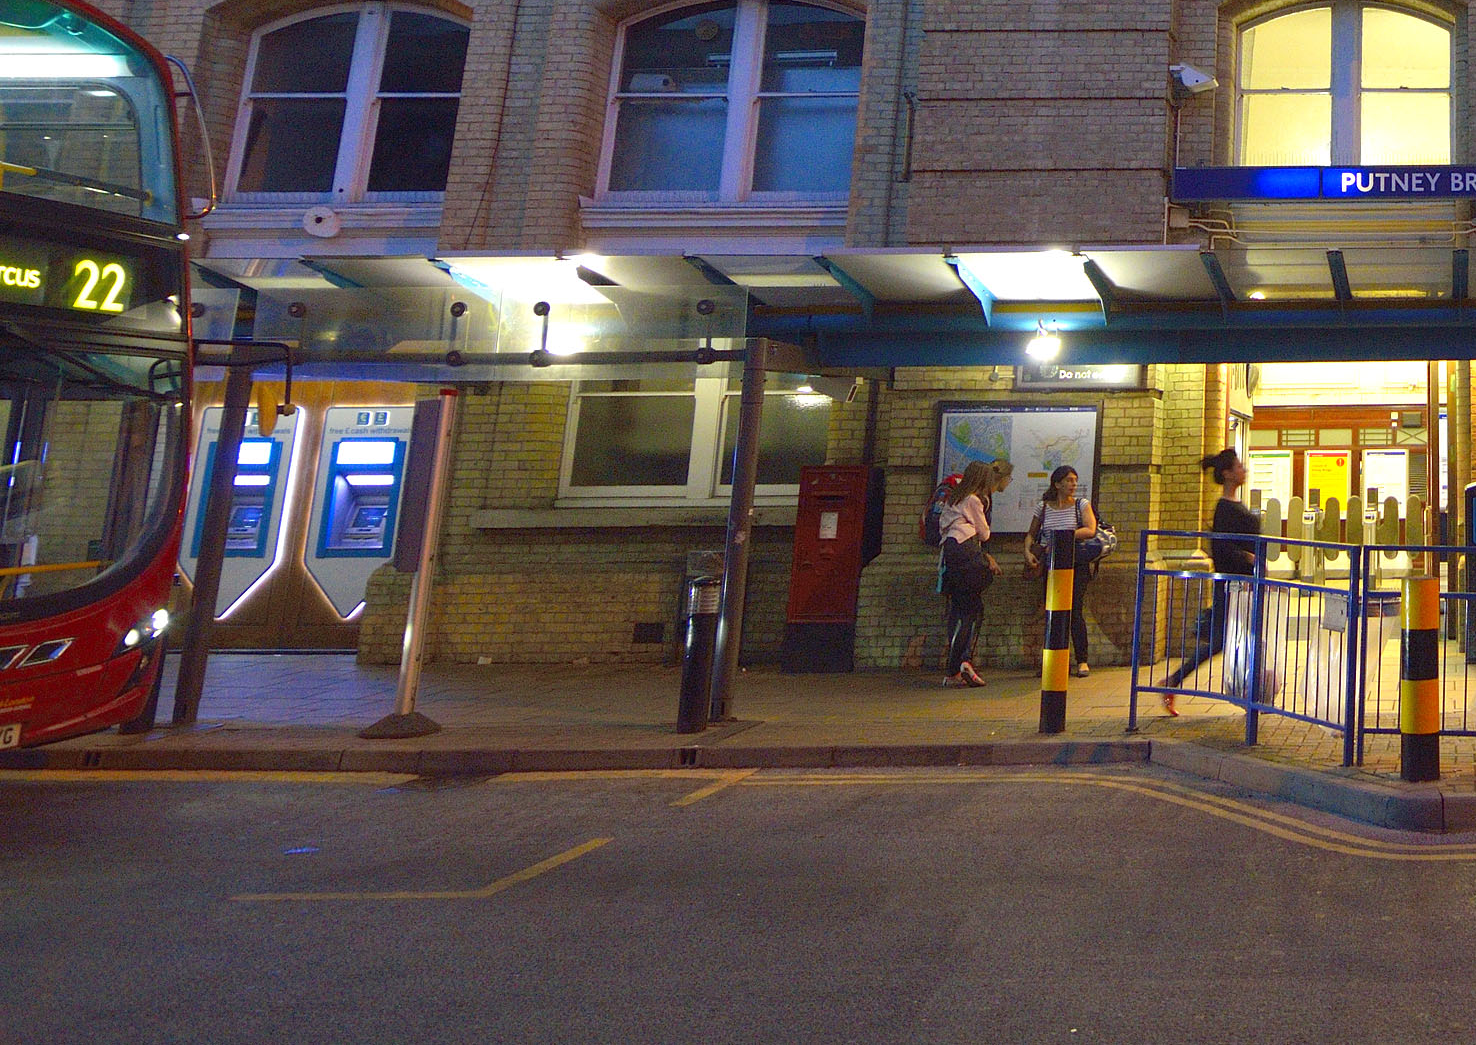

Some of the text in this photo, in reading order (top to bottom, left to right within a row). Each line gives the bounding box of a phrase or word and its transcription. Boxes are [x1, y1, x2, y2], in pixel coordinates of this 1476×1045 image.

[1341, 172, 1441, 193] PUTNEY
[73, 259, 126, 312] 22
[1058, 369, 1074, 379] Do
[1074, 369, 1091, 379] not
